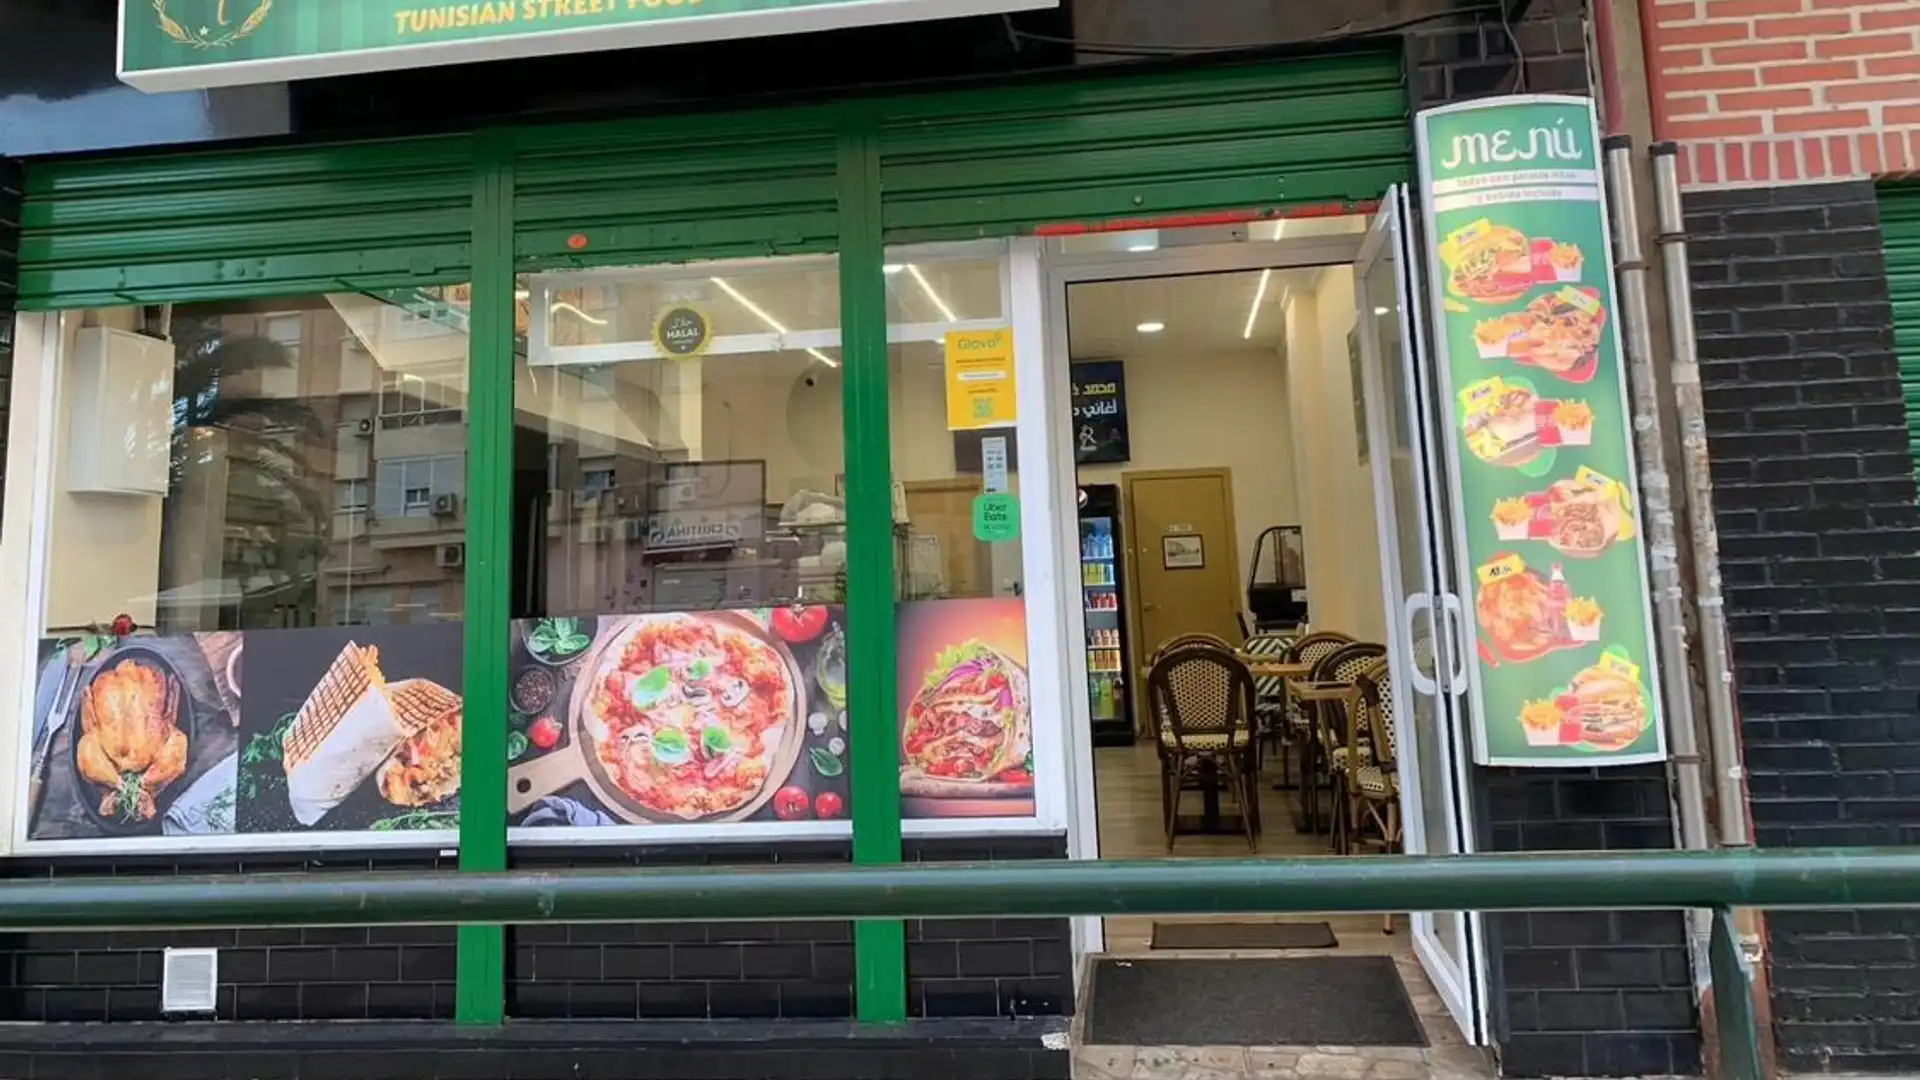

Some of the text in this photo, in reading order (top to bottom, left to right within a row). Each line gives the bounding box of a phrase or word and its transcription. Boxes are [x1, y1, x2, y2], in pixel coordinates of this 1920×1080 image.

[394, 0, 516, 34] TUNISIAN
[667, 328, 699, 340] HALAL
[957, 338, 997, 350] Glovo
[983, 502, 1007, 511] Uber
[983, 511, 1008, 521] Eats
